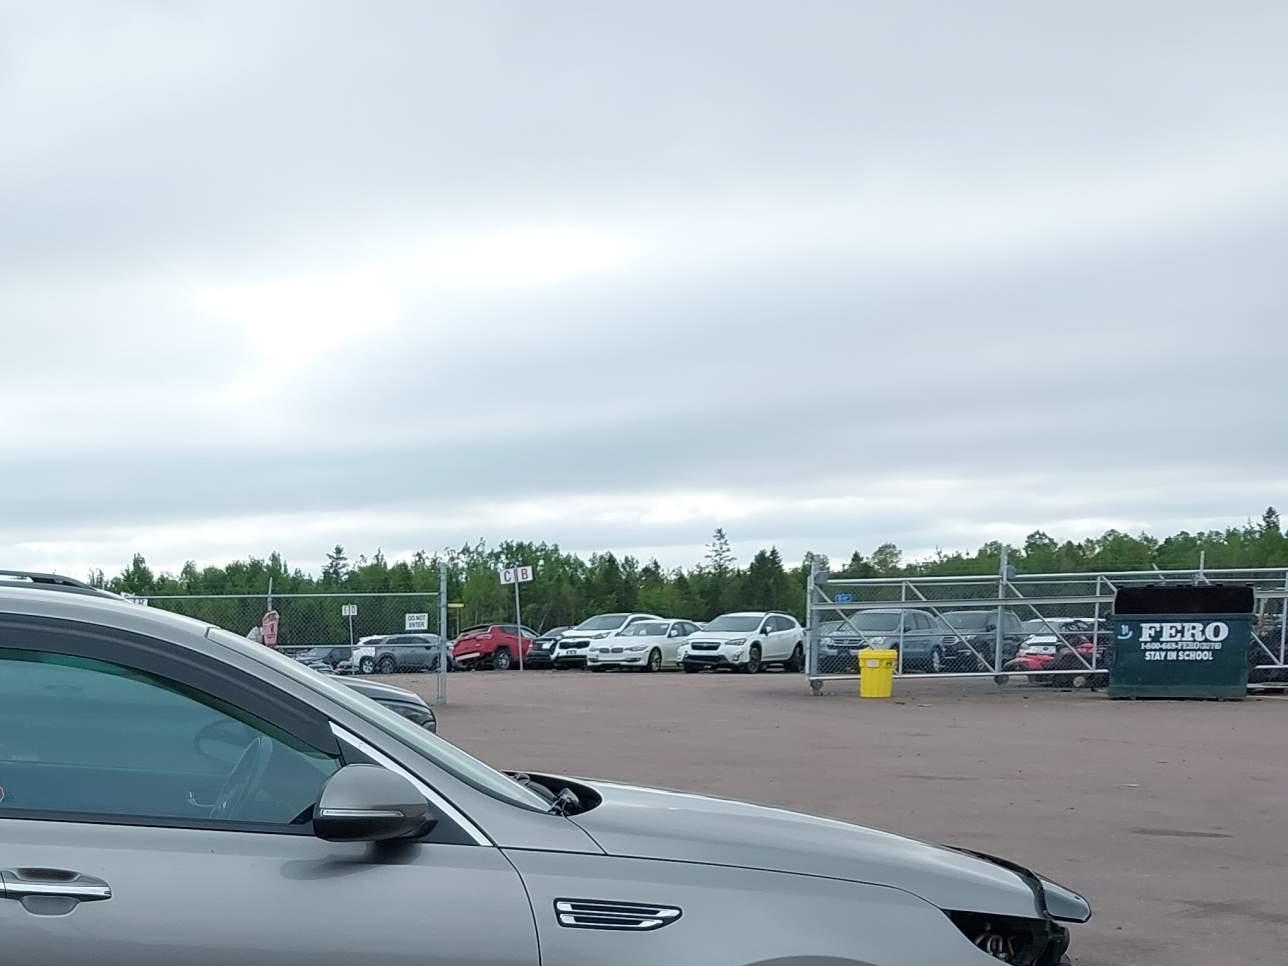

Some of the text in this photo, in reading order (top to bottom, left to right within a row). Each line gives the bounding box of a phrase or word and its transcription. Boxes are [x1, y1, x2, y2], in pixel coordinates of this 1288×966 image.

[520, 568, 529, 580] B
[1139, 622, 1229, 642] FERO
[1145, 651, 1214, 660] STAY IN SCHOOL
